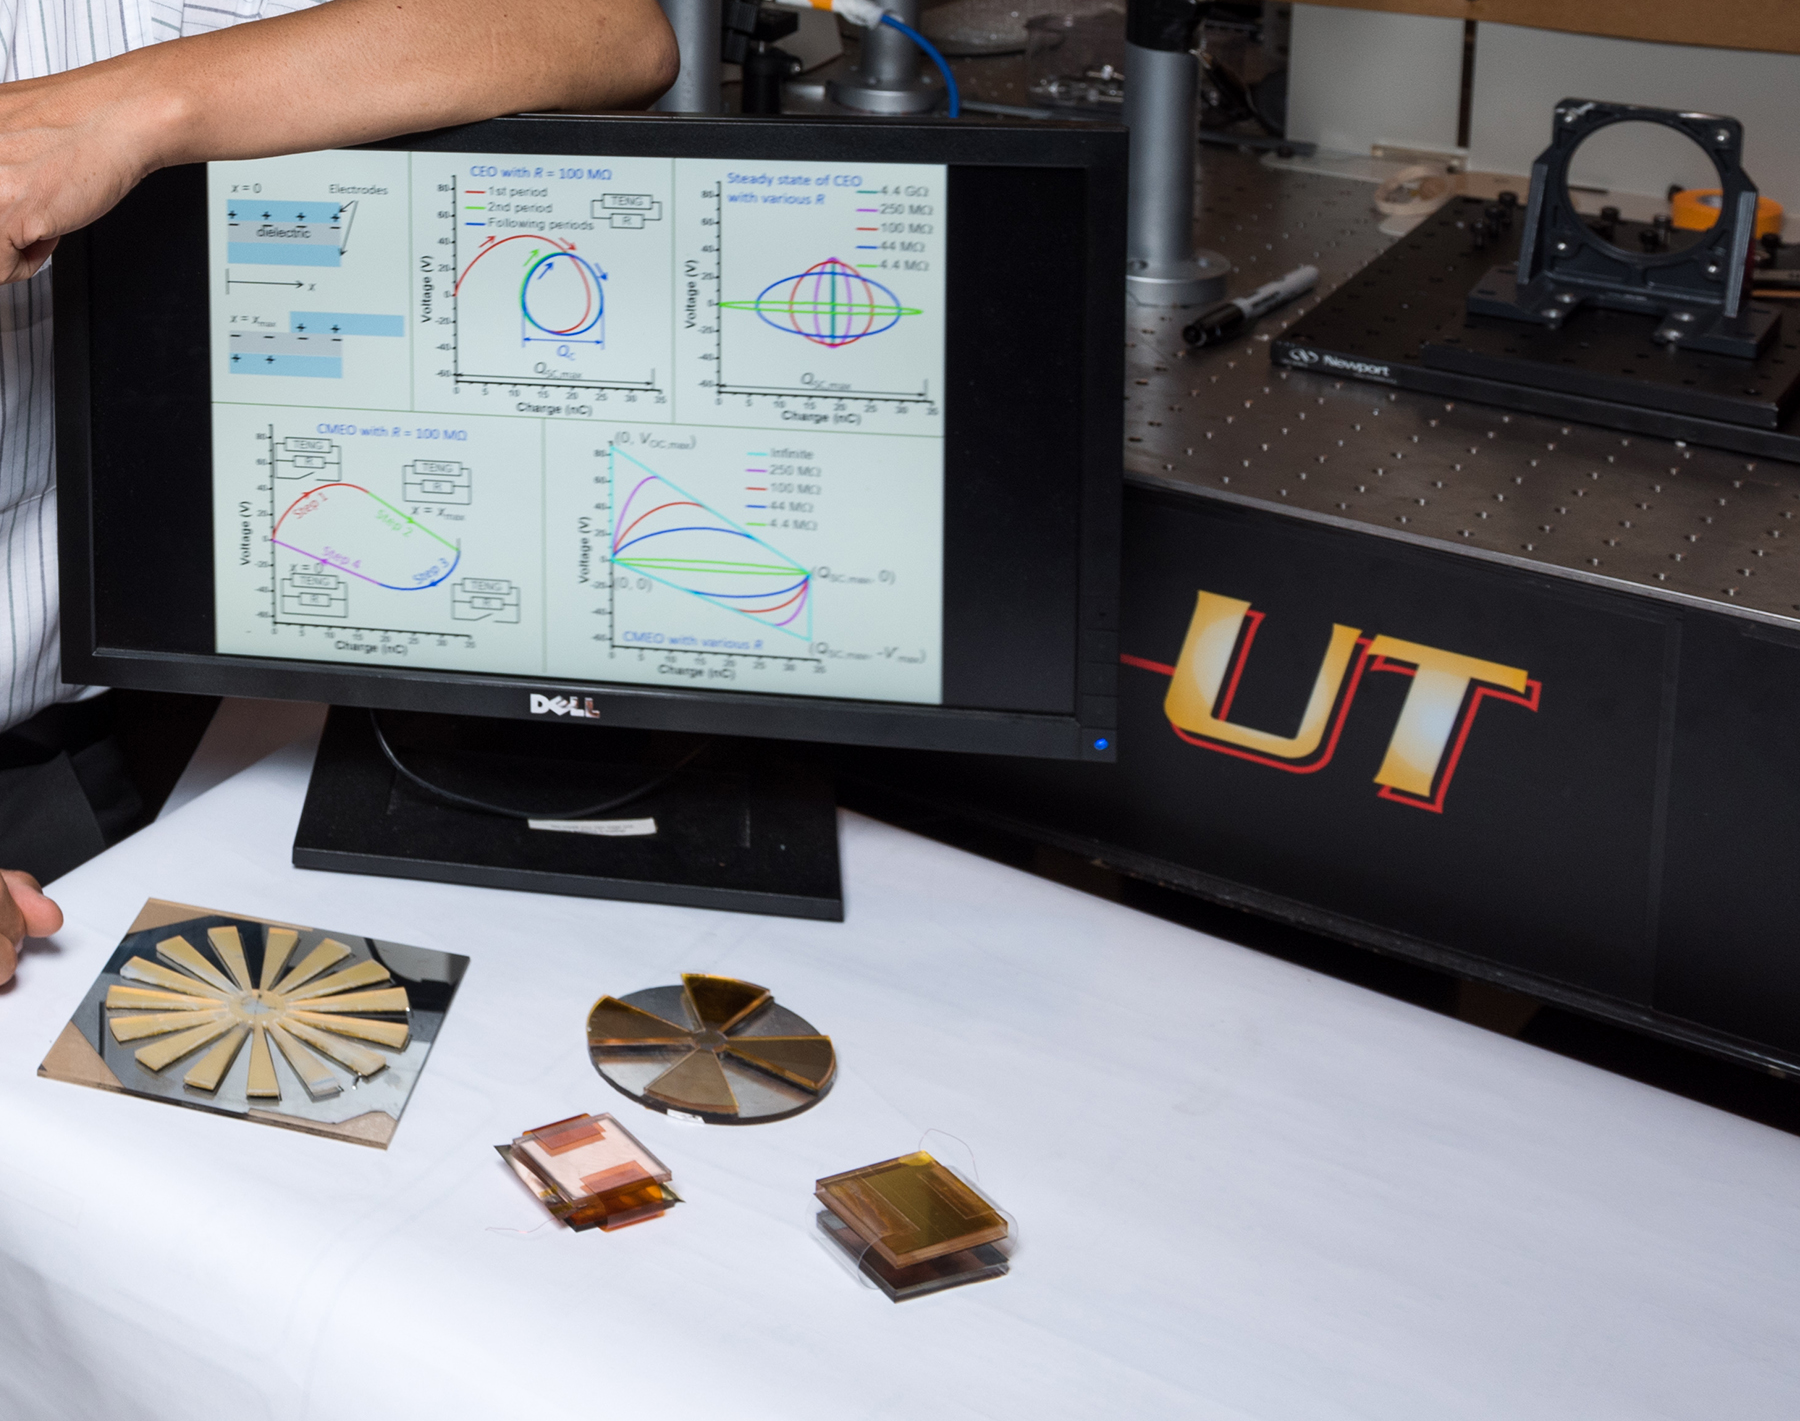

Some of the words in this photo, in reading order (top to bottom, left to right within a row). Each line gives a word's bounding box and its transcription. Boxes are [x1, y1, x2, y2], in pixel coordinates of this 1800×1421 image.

[470, 166, 498, 178] CEO
[501, 166, 531, 179] with
[533, 167, 544, 179] R
[558, 168, 585, 180] 100
[727, 172, 773, 186] Steady
[777, 174, 811, 186] state
[815, 174, 831, 186] of
[833, 175, 863, 187] CEO
[329, 184, 389, 196] Electrodes
[488, 186, 507, 197] 1st
[509, 187, 549, 199] period
[727, 191, 758, 203] with
[761, 193, 812, 205] various
[815, 193, 826, 205] R
[488, 202, 511, 213] 2nd
[514, 203, 553, 215] period
[611, 196, 644, 207] TENG
[256, 227, 312, 239] dielectric
[488, 218, 545, 231] Following
[549, 220, 595, 232] periods
[420, 255, 434, 273] (V)
[421, 275, 435, 323] Voltage
[685, 281, 699, 329] Voltage
[1322, 354, 1391, 377] Newport
[516, 402, 562, 416] Charge
[565, 403, 593, 417] (nC)
[781, 410, 829, 424] Charge
[833, 411, 862, 425] (nC)
[316, 423, 357, 436] CMEO
[360, 425, 388, 437] with
[390, 427, 401, 438] R
[415, 427, 440, 439] 100
[422, 462, 454, 473] TENG
[292, 499, 320, 519] Step
[375, 508, 403, 532] Step
[240, 518, 252, 566] Voltage
[321, 546, 350, 566] Step
[579, 535, 592, 584] Voltage
[412, 564, 441, 585] Step
[622, 630, 665, 645] CMEO
[669, 633, 699, 647] with
[702, 636, 751, 649] various
[335, 640, 379, 654] Charge
[382, 642, 408, 656] (nC)
[657, 663, 704, 678] Charge
[529, 693, 601, 719] DELL
[1164, 590, 1541, 813] UT
